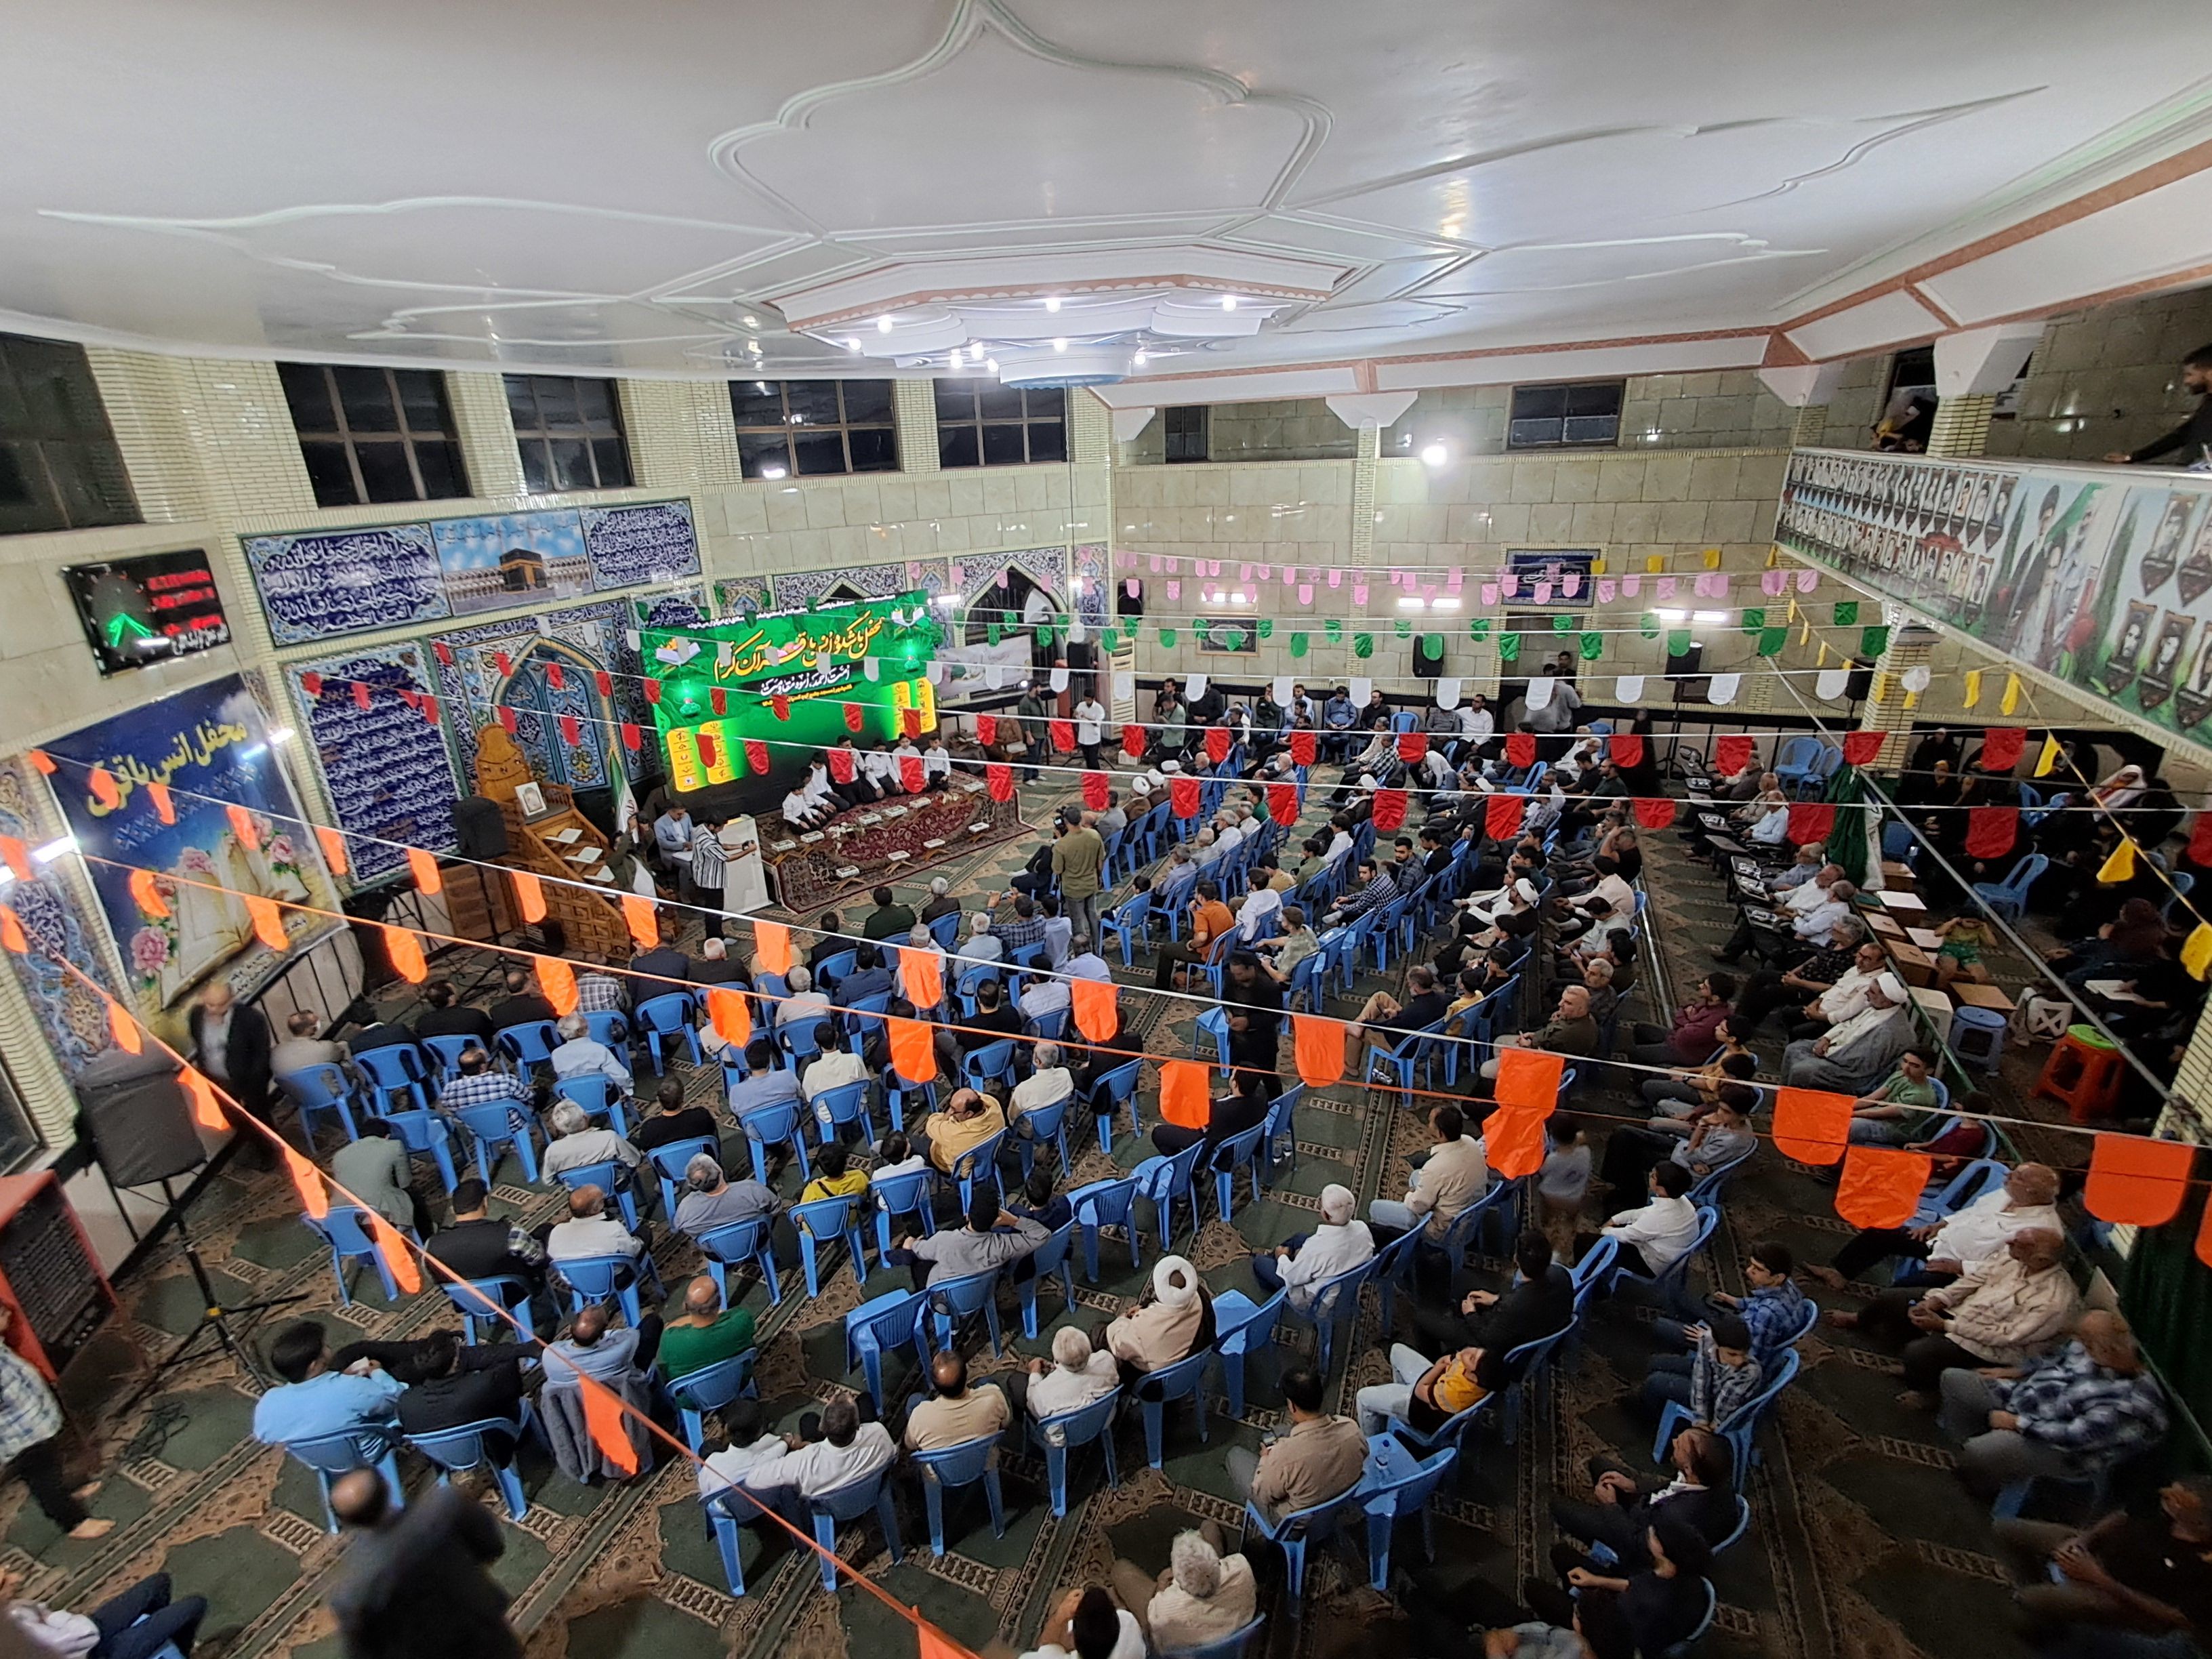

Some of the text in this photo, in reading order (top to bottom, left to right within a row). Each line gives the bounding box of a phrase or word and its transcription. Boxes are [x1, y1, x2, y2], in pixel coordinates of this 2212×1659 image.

[735, 631, 806, 676] قرآن
[848, 615, 885, 659] محفل
[152, 732, 194, 786] انس
[194, 720, 247, 766] محفل
[88, 756, 134, 817] قرن
